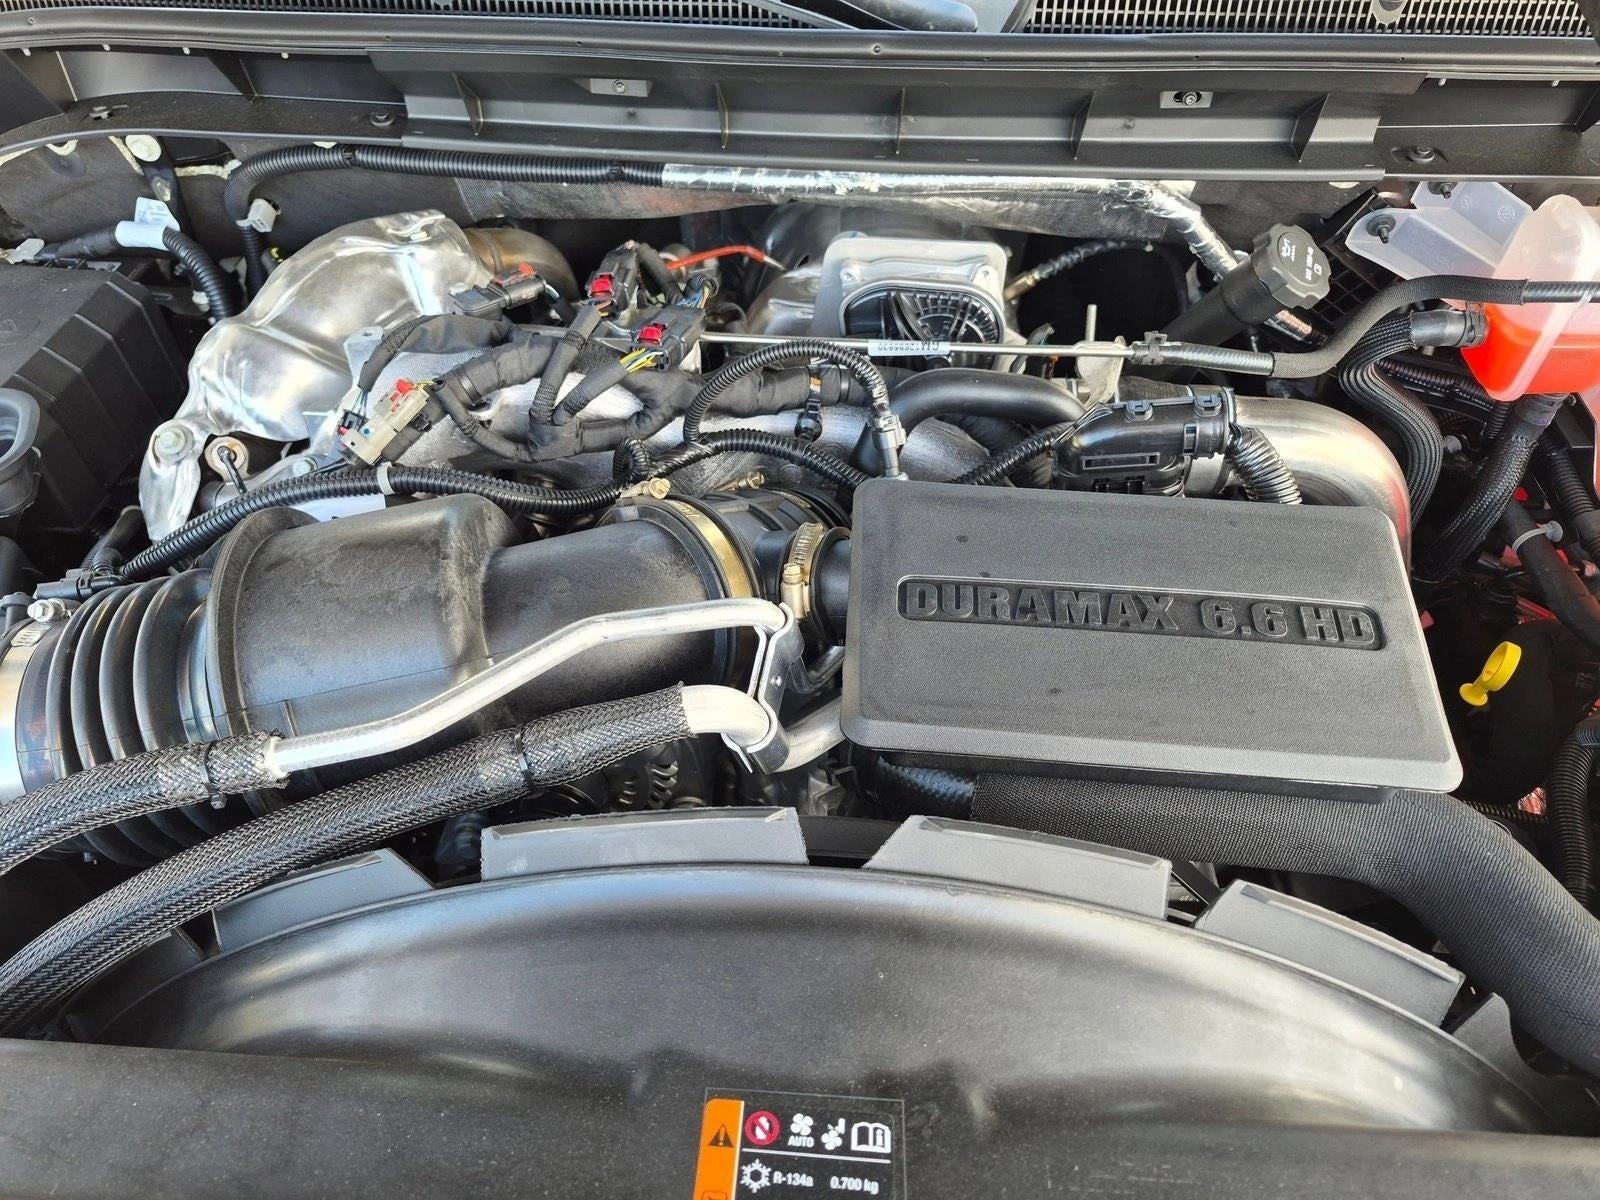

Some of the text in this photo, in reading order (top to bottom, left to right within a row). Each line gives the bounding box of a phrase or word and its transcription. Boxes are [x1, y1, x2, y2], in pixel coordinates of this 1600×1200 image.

[905, 581, 1378, 647] DURAMAX 6.6 HD
[788, 1135, 815, 1148] AUTO
[773, 1170, 880, 1195] R-134a 0.700 kg
